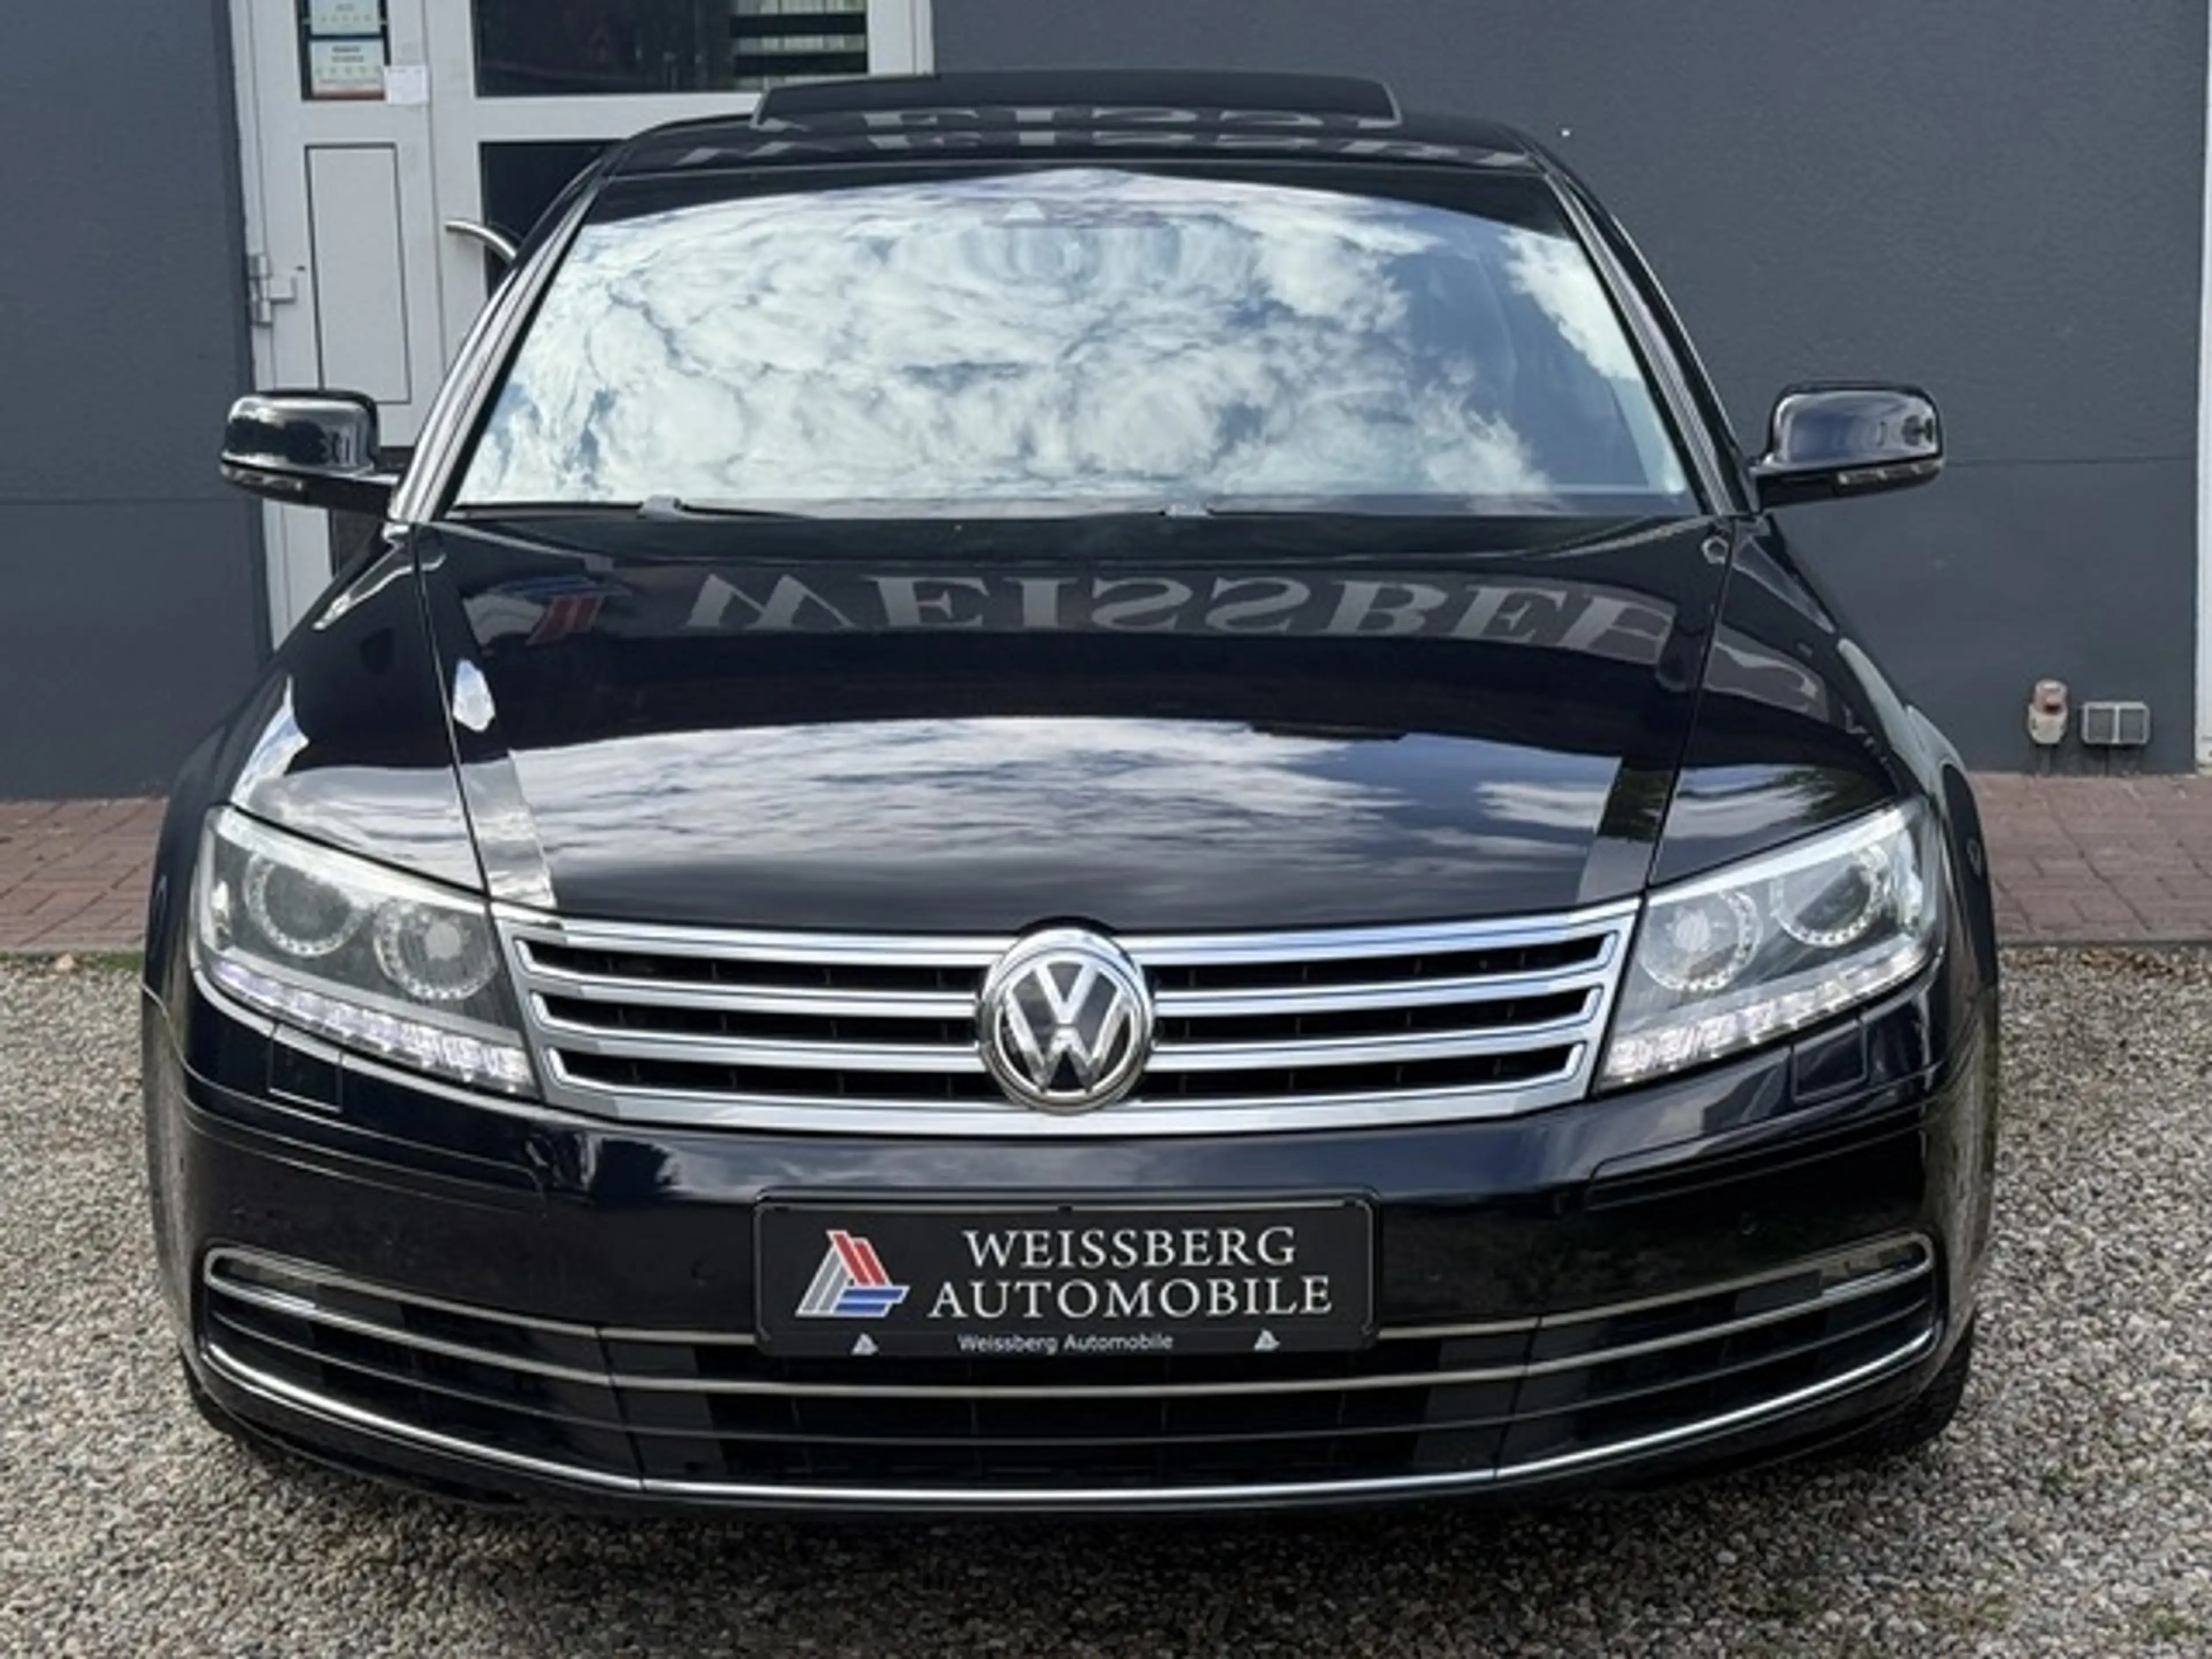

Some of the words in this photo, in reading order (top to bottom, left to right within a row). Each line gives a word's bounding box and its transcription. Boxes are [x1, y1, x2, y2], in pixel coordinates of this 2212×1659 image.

[961, 1226, 1297, 1268] WEISSBERG
[927, 1275, 1333, 1319] AUTOMOBILE
[957, 1332, 1058, 1355] Weissberg
[1063, 1331, 1174, 1350] Automobile
